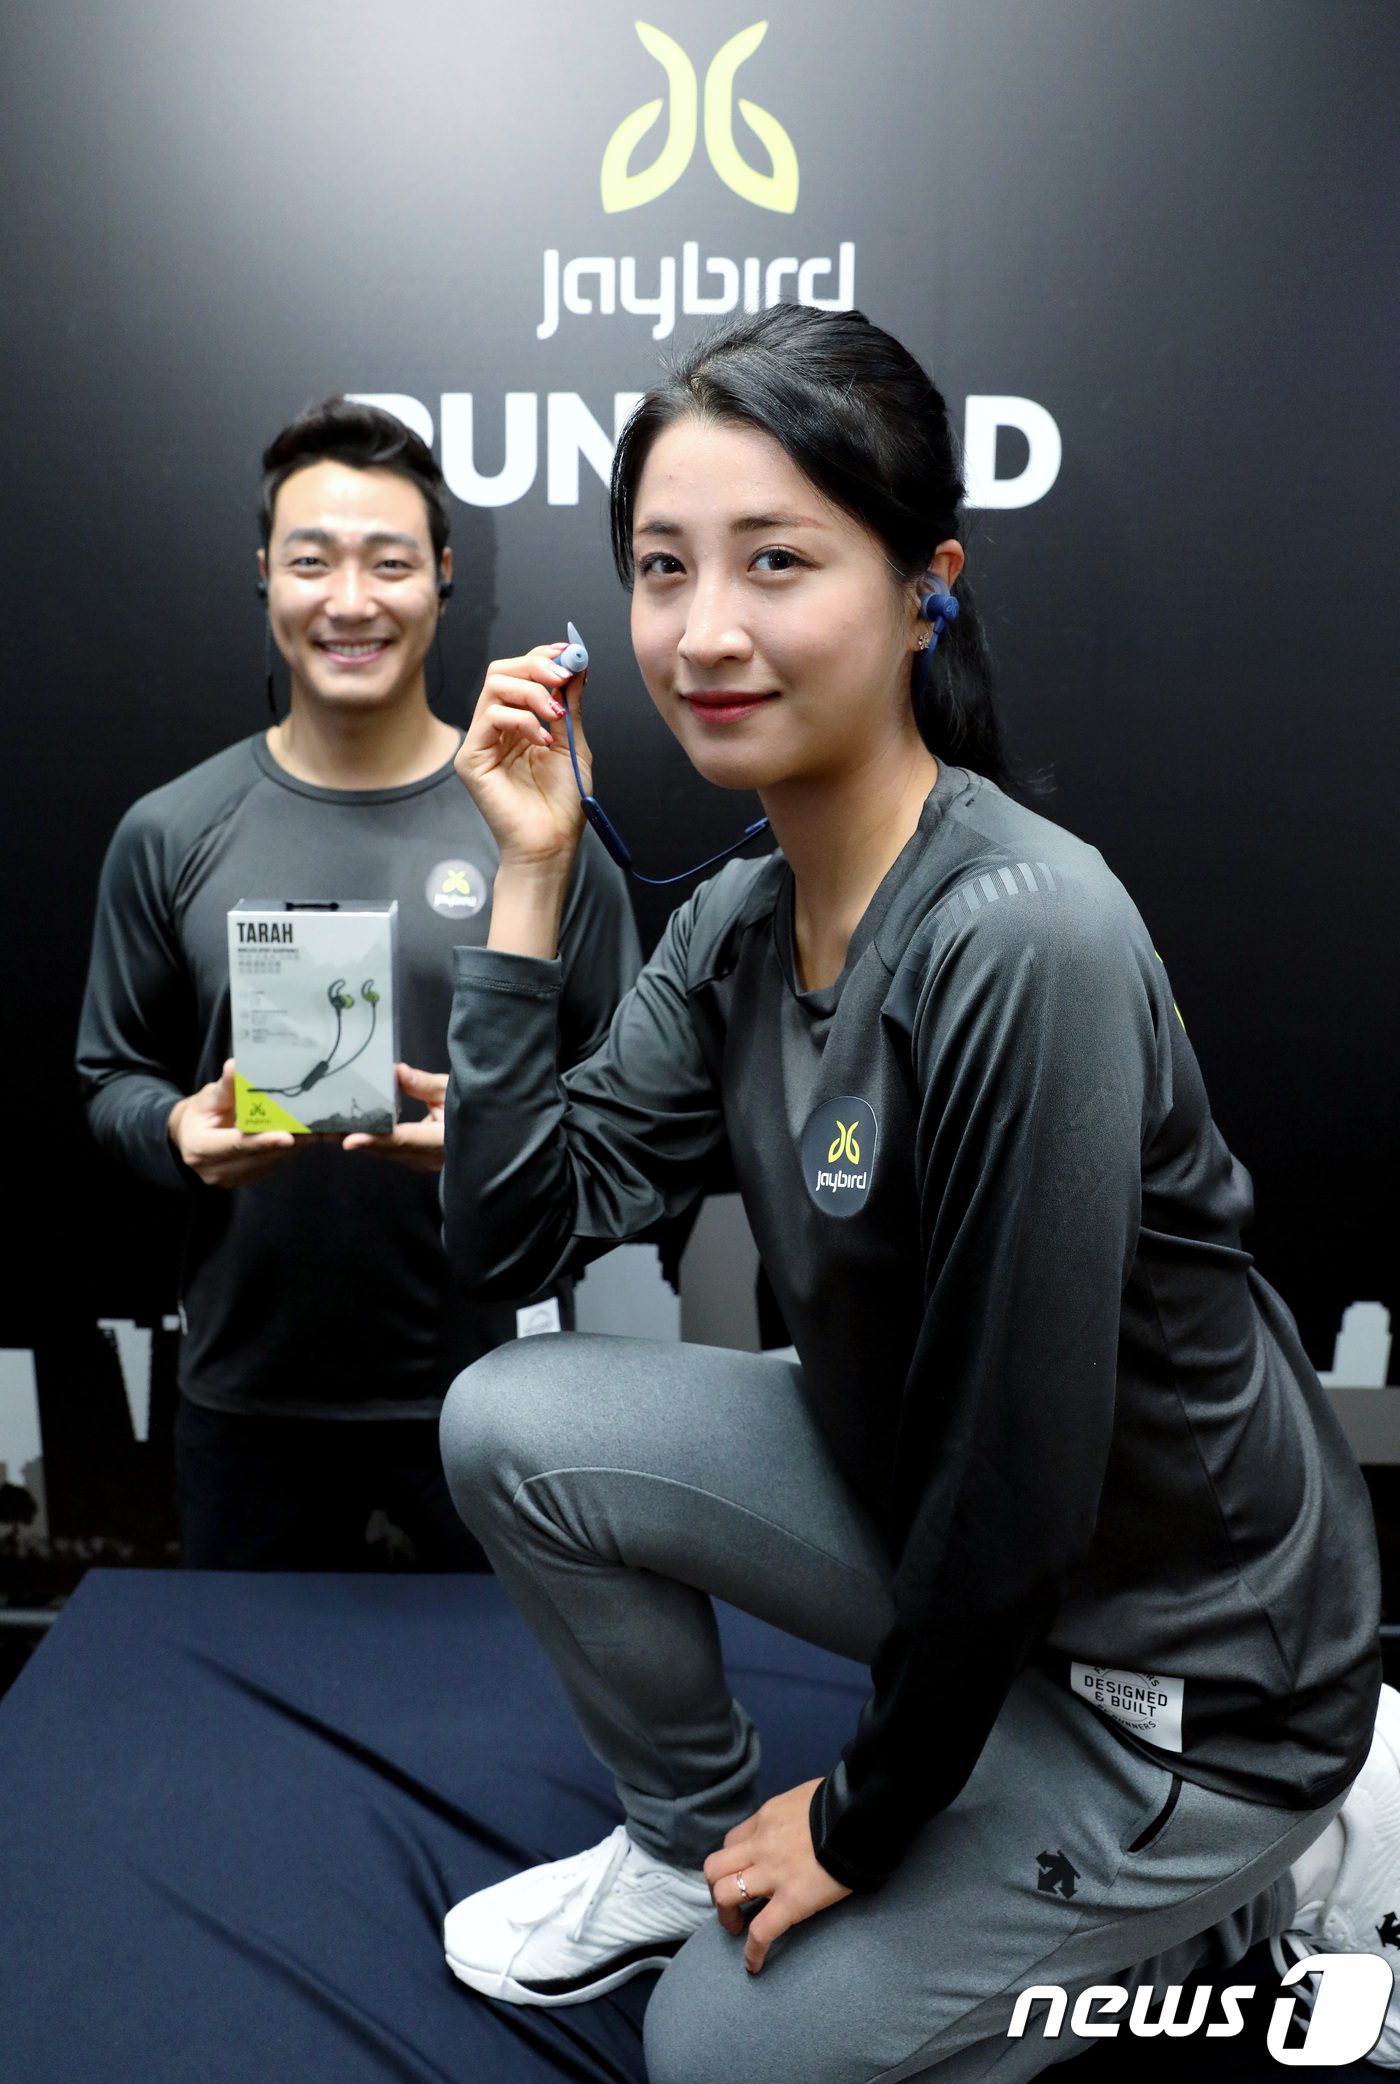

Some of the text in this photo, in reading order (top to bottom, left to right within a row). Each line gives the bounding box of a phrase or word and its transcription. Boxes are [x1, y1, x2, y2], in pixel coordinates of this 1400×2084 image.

[537, 241, 855, 340] jaybird
[237, 922, 293, 943] TARAH
[815, 1170, 867, 1193] jaybird
[1084, 1675, 1168, 1707] DESIGNED
[1095, 1691, 1104, 1702] &
[1111, 1695, 1156, 1717] BUILT
